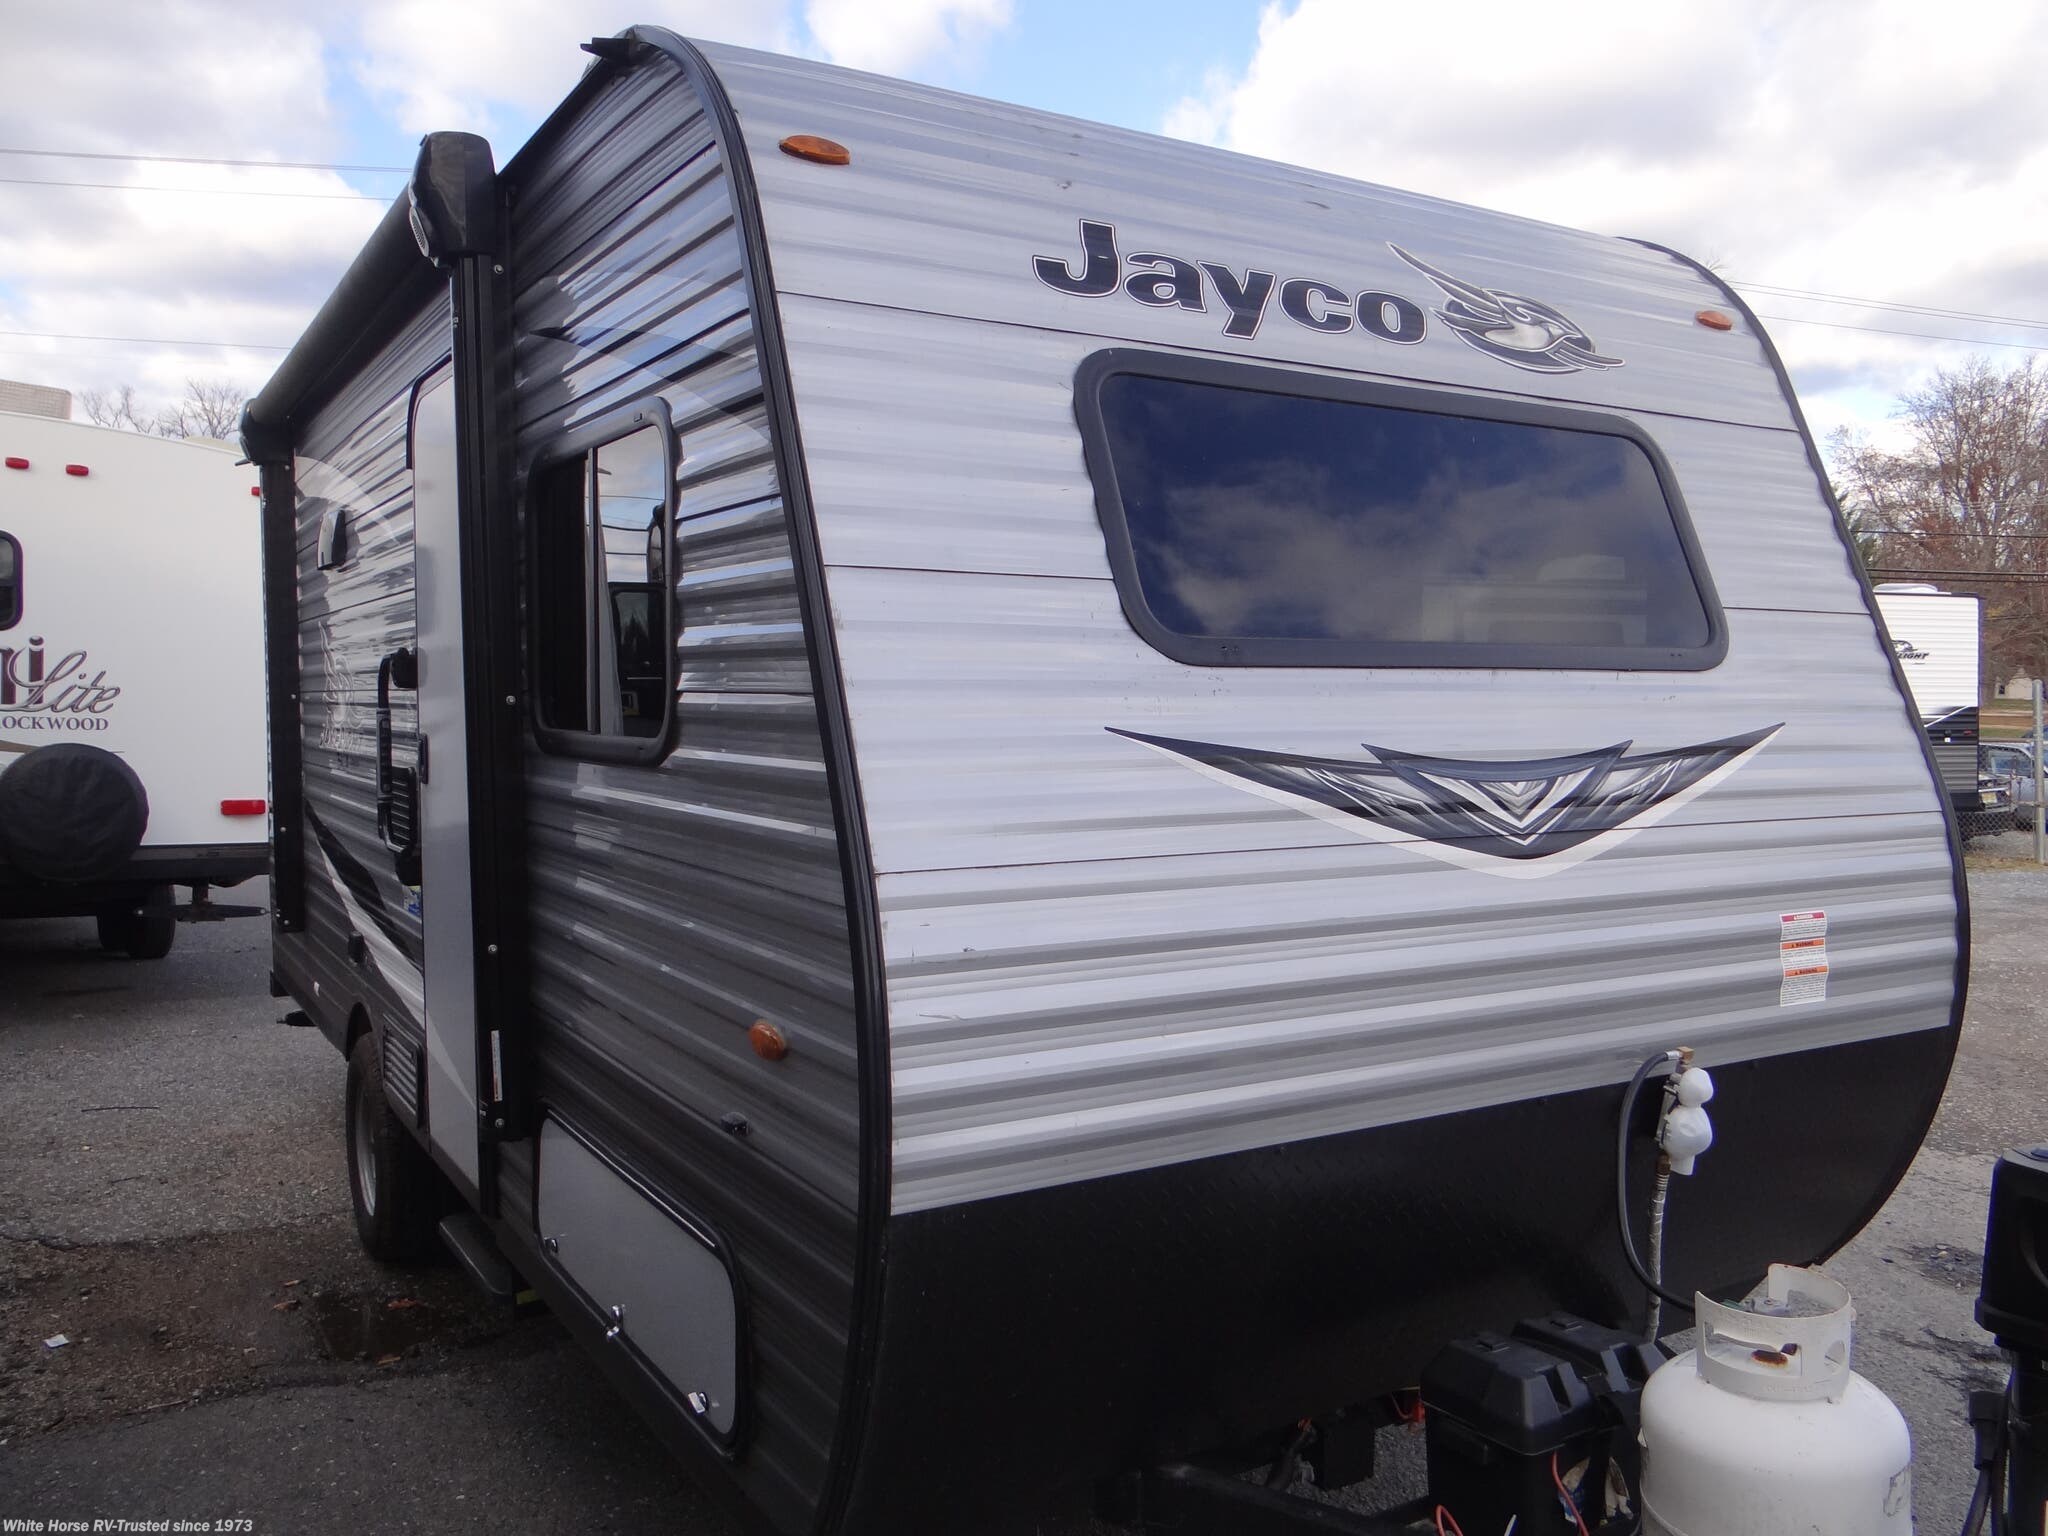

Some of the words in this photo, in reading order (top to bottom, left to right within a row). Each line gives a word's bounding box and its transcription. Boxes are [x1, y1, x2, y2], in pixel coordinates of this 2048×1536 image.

[1032, 218, 1428, 345] Jayco
[8, 650, 121, 714] Lite
[0, 715, 109, 731] OCKWOOD
